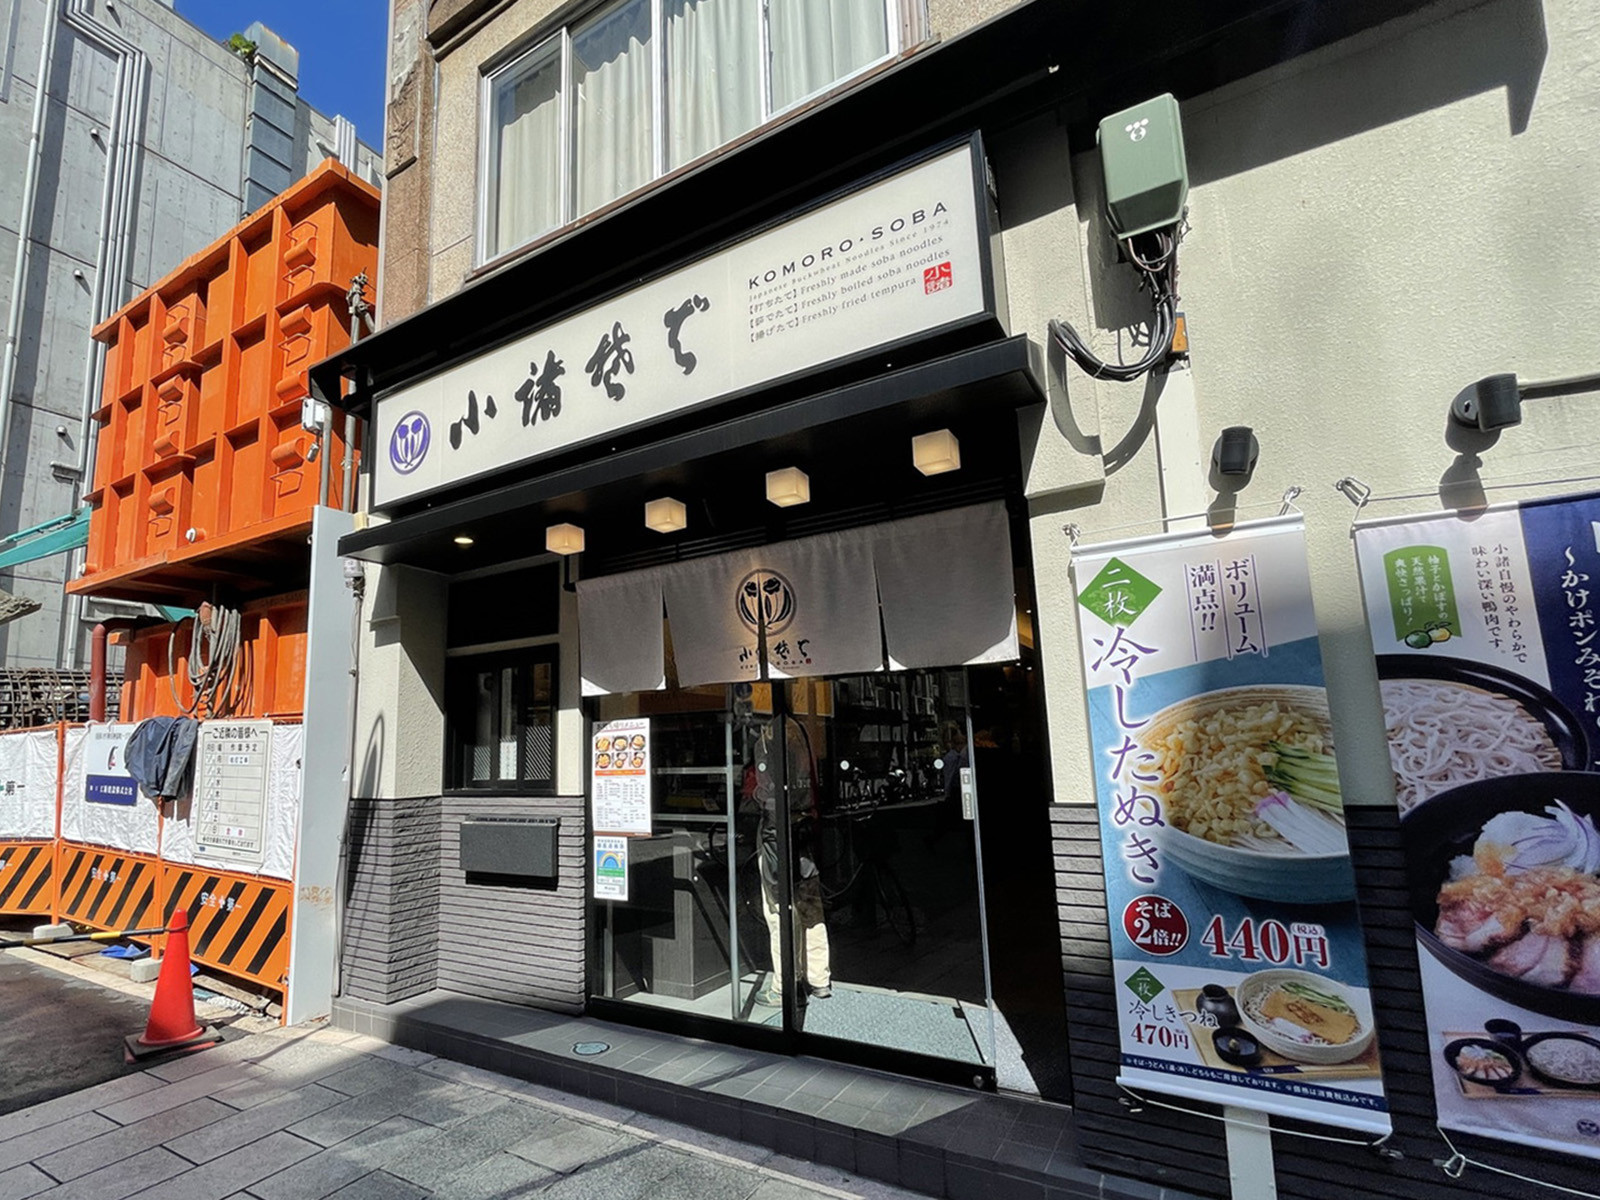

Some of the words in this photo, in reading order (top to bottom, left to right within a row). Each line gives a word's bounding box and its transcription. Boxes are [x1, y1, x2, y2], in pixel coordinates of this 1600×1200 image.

[749, 282, 787, 302] Japanese
[791, 261, 841, 285] Buckwheat
[845, 245, 885, 264] Noodles
[889, 231, 917, 247] Since
[924, 218, 949, 233] 1974
[801, 275, 837, 295] Freshly
[840, 264, 868, 280] made
[871, 253, 896, 268] soba
[899, 235, 944, 257] noodles
[801, 290, 838, 309] Freshly
[841, 275, 873, 294] boiled
[876, 267, 902, 281] soba
[905, 248, 950, 270] noodles
[802, 305, 838, 323] Freshly
[841, 293, 867, 309] fried
[870, 277, 916, 299] tempura
[1102, 568, 1137, 619] 二枚
[1190, 564, 1219, 631] 満点!!
[1225, 558, 1258, 653] ボリューム
[1472, 545, 1506, 654] 味わい深い鴨肉です。
[1493, 543, 1527, 663] 小諸自慢のやわらかで
[1091, 626, 1165, 883] 冷したぬき
[1133, 917, 1182, 947] 2倍!!
[1135, 900, 1172, 918] そば
[1201, 915, 1328, 967] 440円
[1136, 971, 1153, 997] 二枚
[1128, 1000, 1219, 1028] 冷しきつね
[1130, 1022, 1189, 1050] 470円
